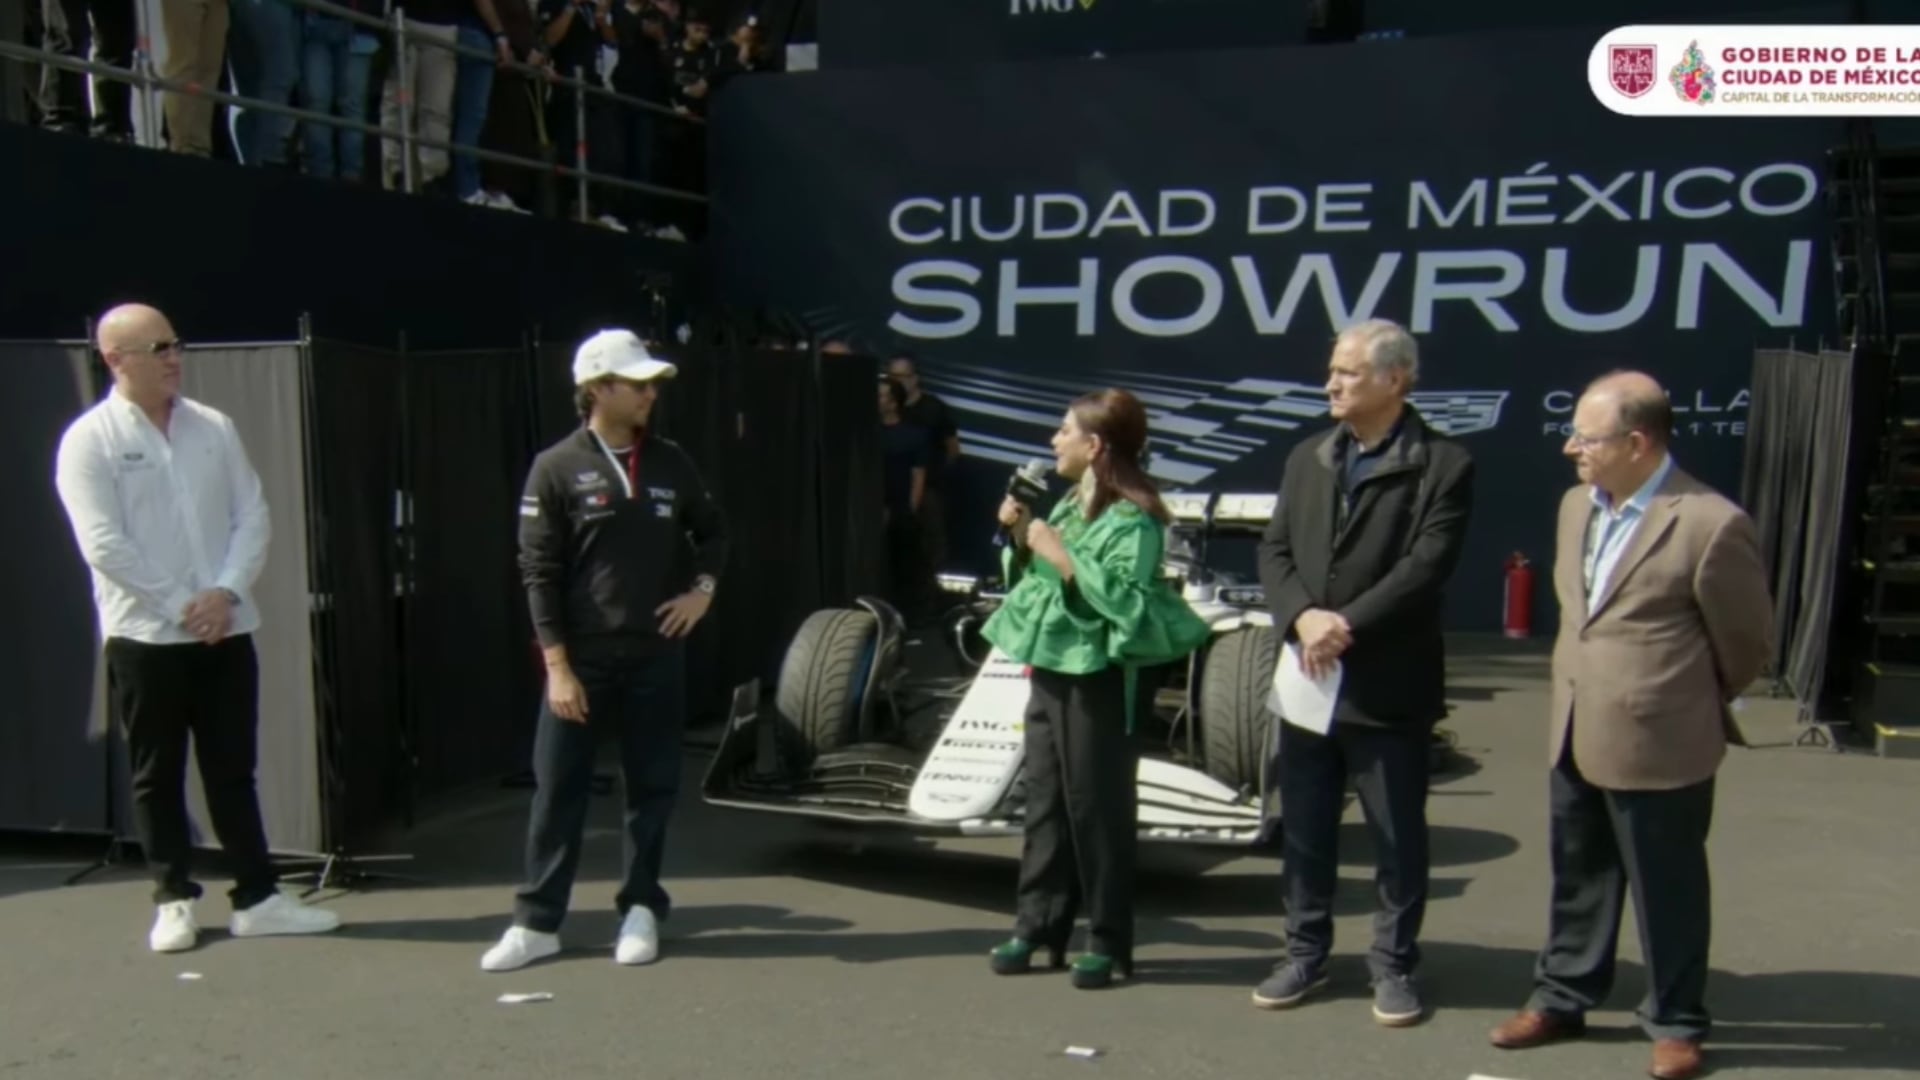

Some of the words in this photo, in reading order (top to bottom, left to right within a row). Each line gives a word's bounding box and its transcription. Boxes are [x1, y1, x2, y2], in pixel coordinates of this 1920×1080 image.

[888, 190, 1216, 244] CIUDAD
[1246, 183, 1373, 235] DE
[1406, 162, 1818, 231] MÉXICO
[886, 239, 1813, 339] SHOWRUN
